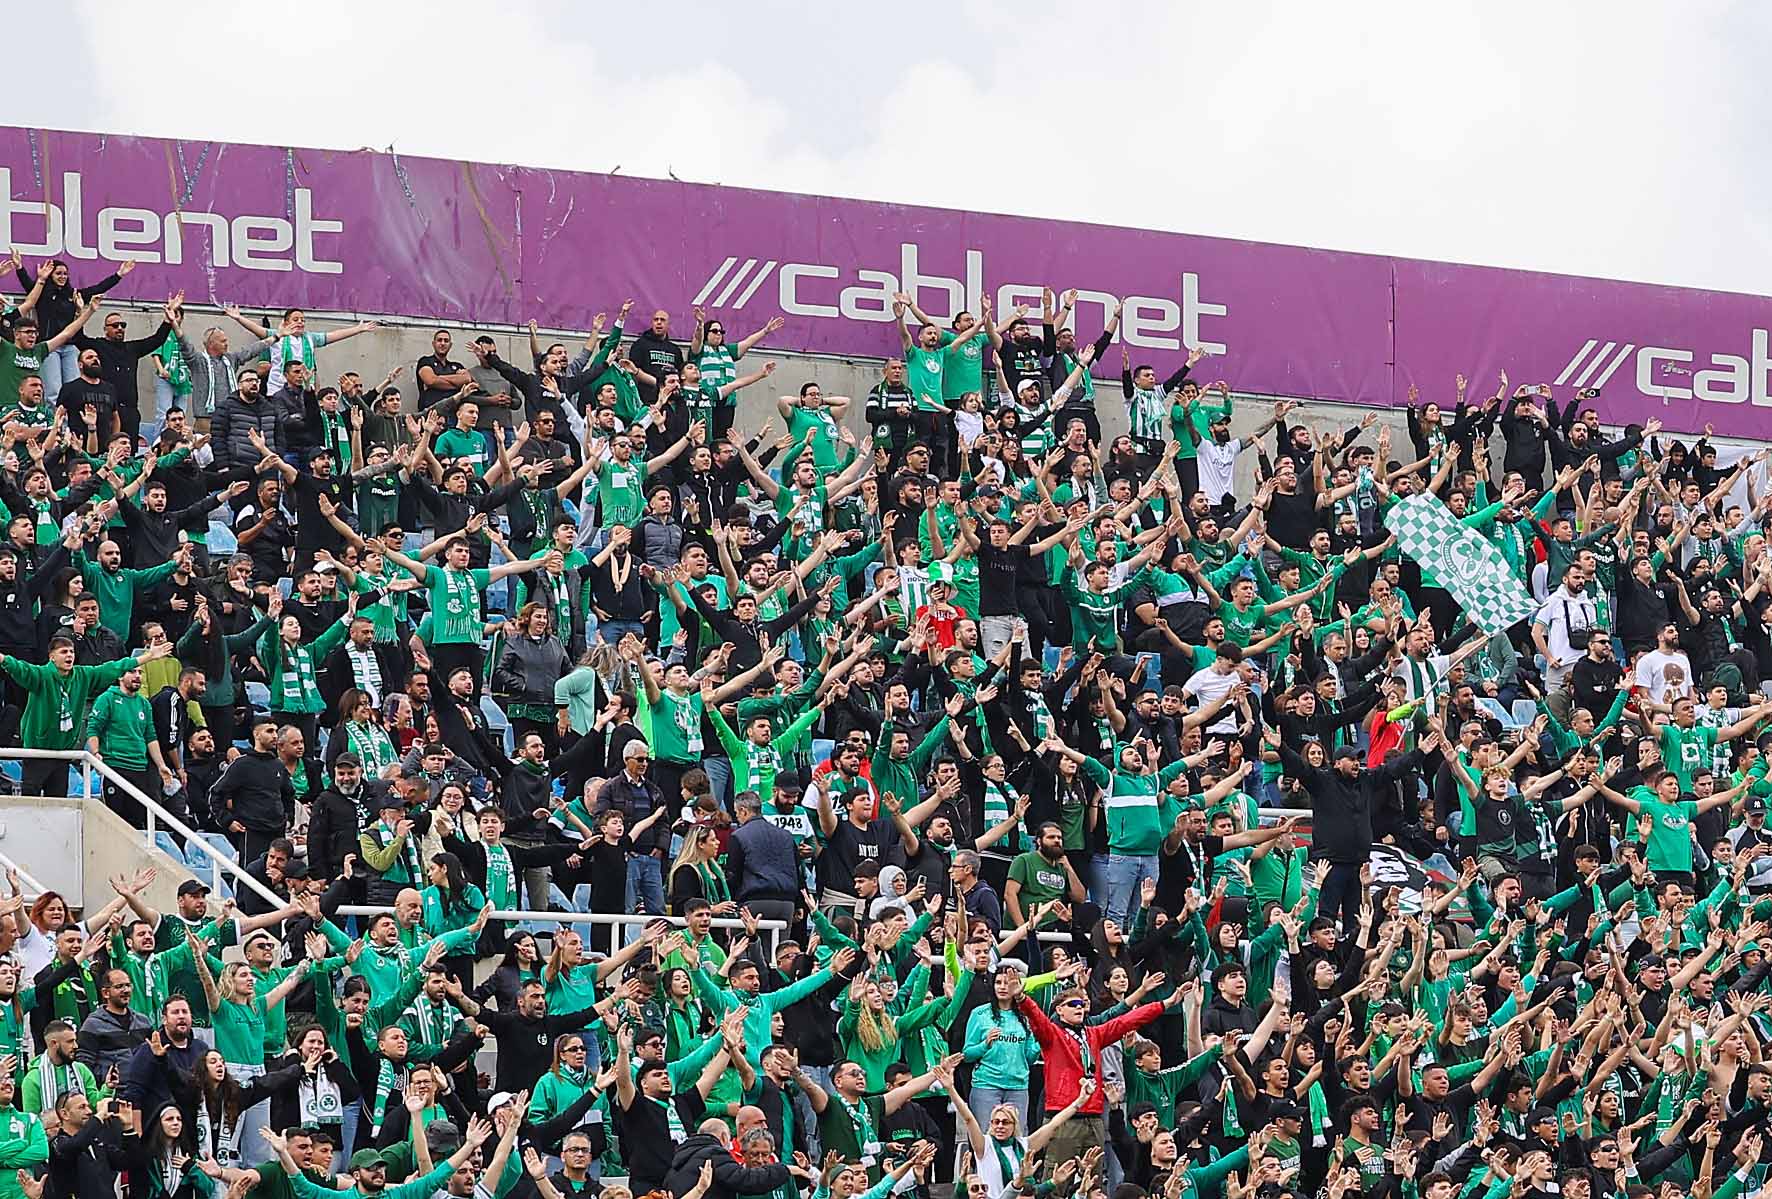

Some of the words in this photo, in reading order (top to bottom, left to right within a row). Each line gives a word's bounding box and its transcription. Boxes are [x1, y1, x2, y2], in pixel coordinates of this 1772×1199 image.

[779, 243, 1227, 356] cablenet
[775, 816, 803, 829] 1948
[997, 1032, 1026, 1043] ovibe
